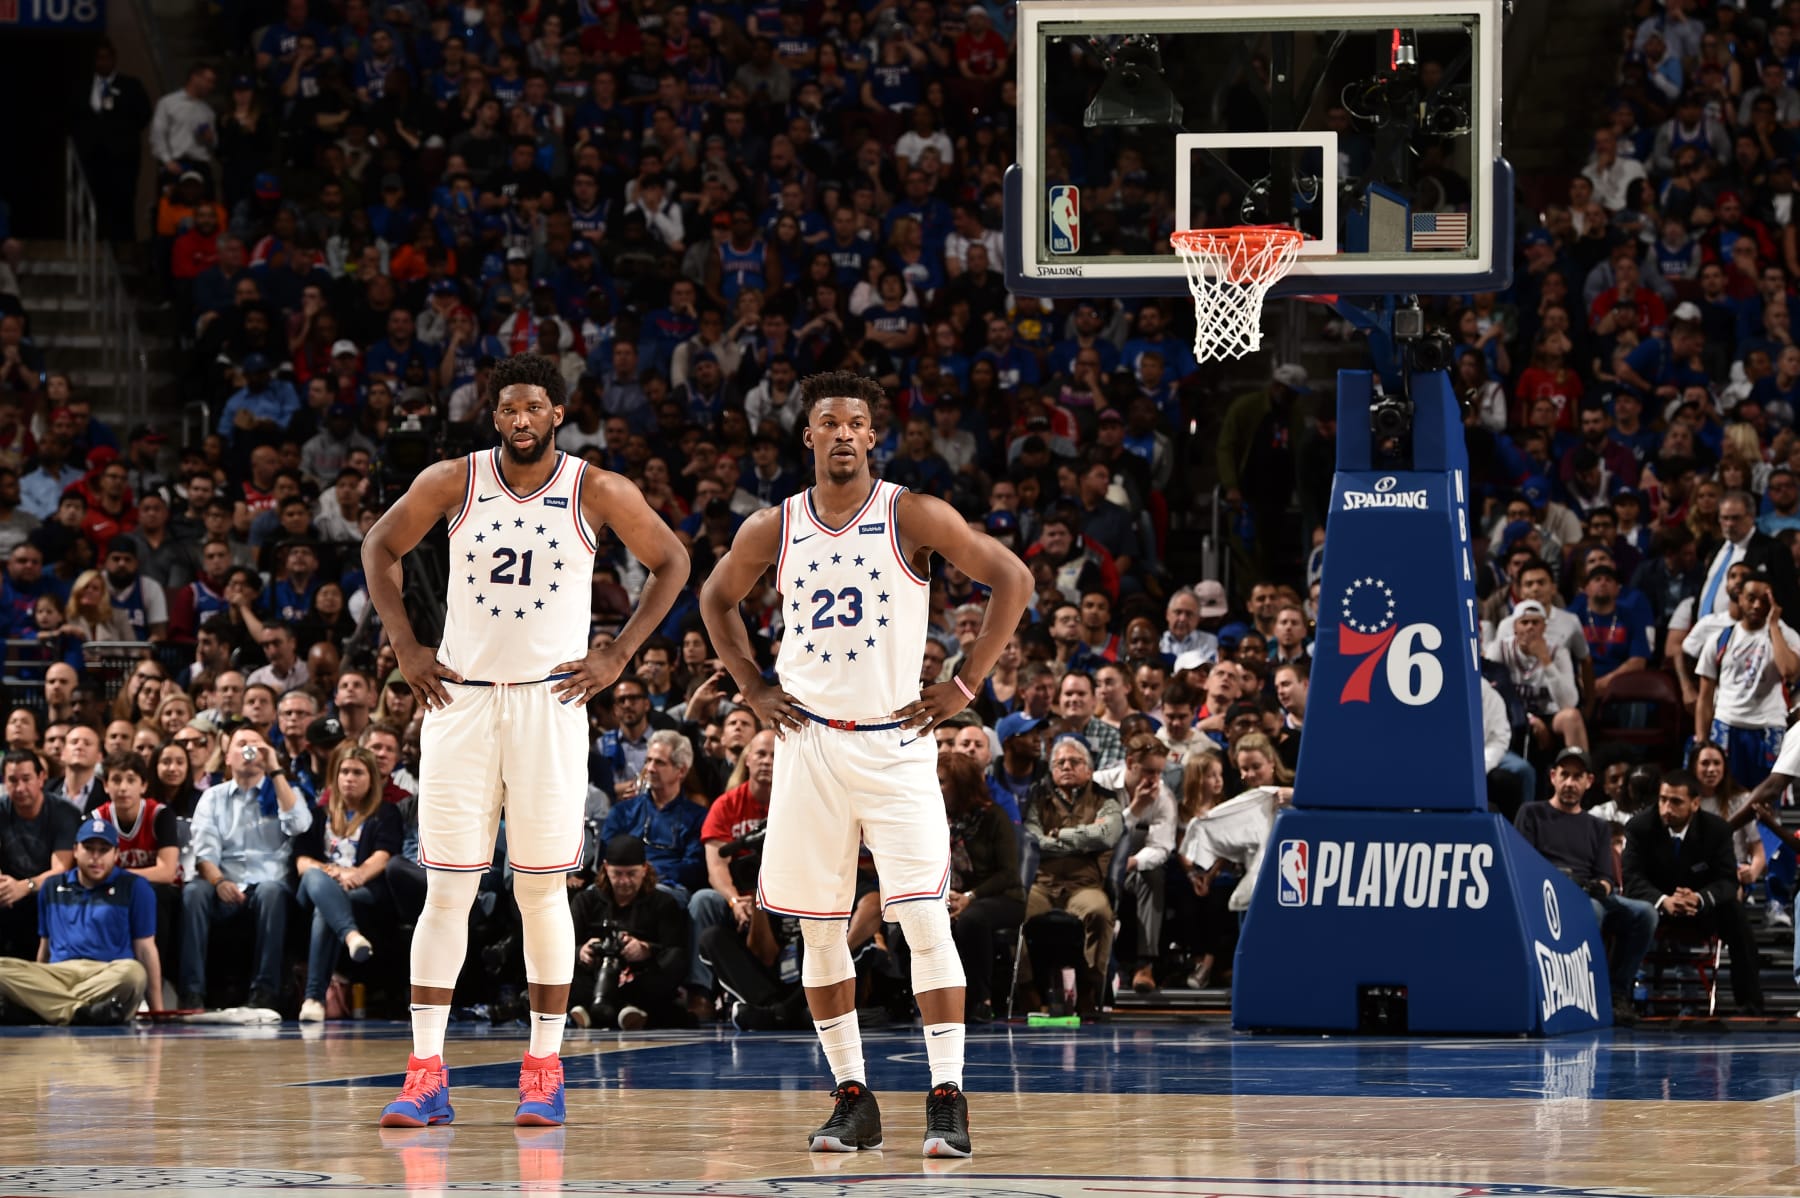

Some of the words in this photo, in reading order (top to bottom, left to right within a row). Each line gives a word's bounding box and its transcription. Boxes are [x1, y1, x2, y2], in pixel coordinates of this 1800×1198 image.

[32, 0, 98, 21] 108
[1054, 238, 1068, 249] NBA
[1037, 266, 1082, 277] SPALDING
[1343, 489, 1428, 511] SPALDING
[490, 546, 533, 586] 21
[1454, 469, 1471, 581] NBA
[1466, 598, 1479, 671] TV
[811, 586, 863, 630] 23
[1338, 622, 1444, 706] 76
[1312, 841, 1493, 909] PLAYOFFS
[1282, 890, 1297, 902] NBA
[1535, 940, 1599, 1021] SPALDING
